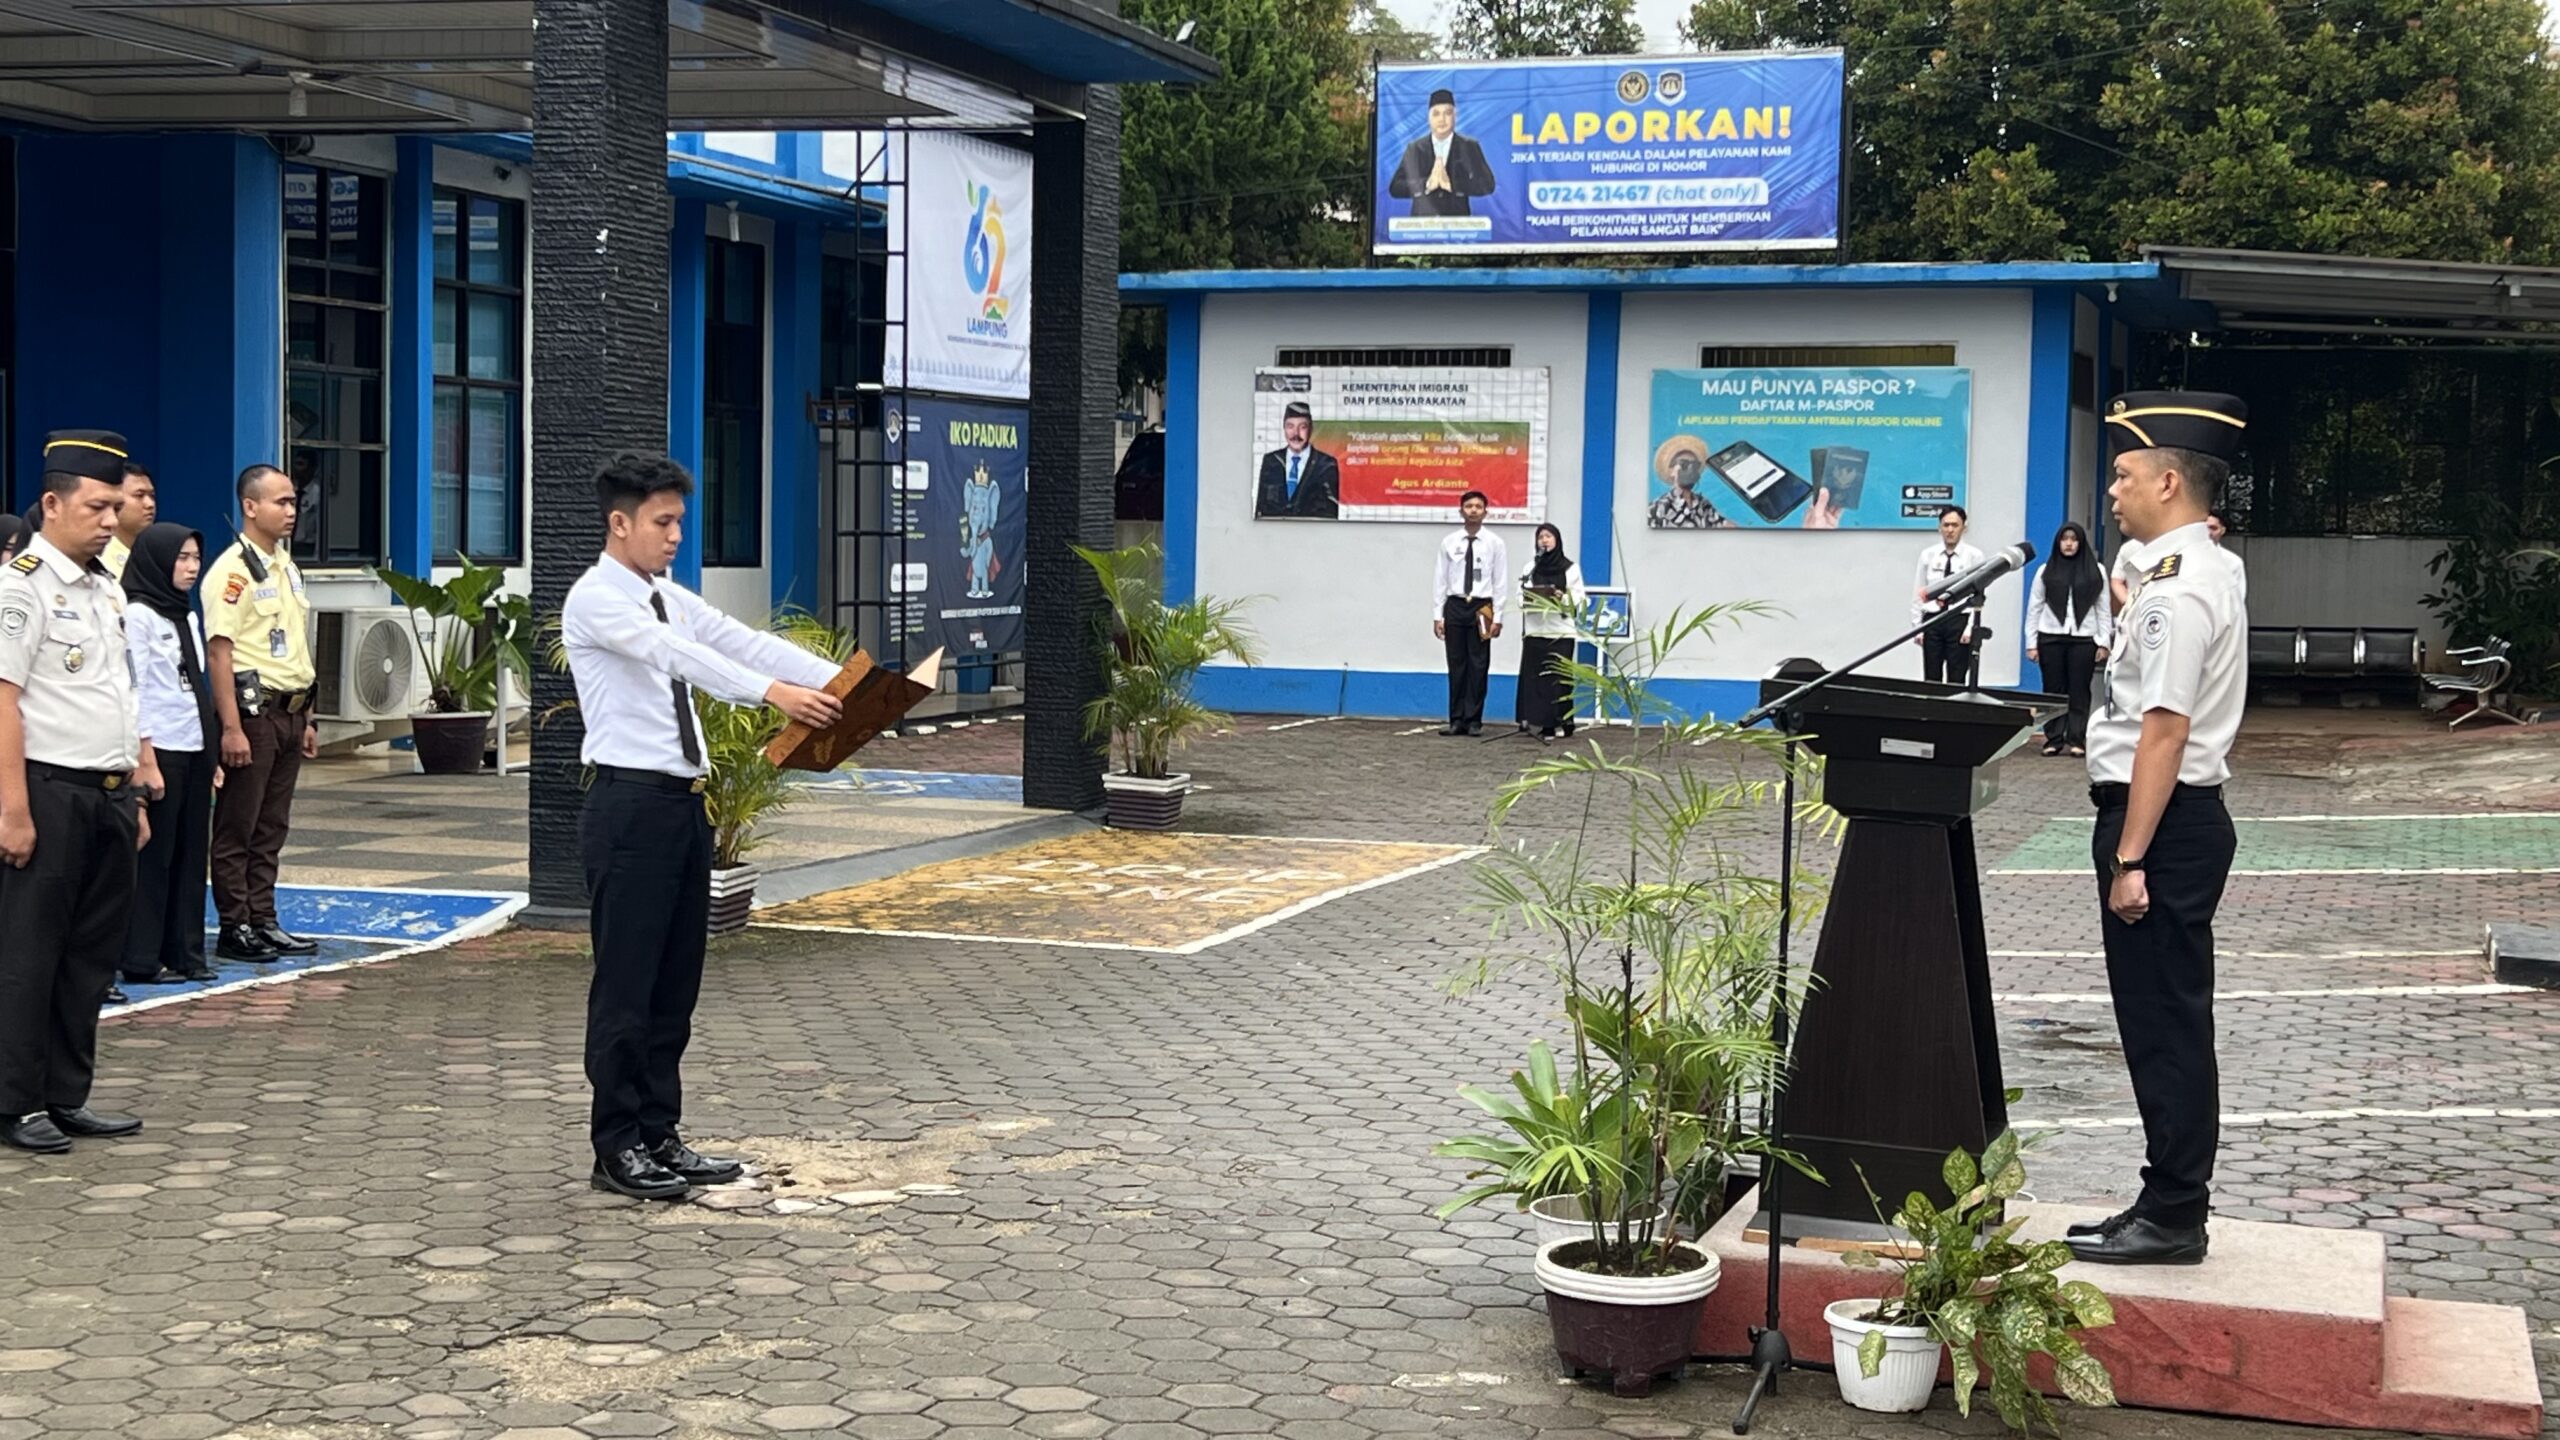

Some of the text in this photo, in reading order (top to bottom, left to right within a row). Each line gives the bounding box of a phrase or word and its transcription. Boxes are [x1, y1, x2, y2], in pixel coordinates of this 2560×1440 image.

[1511, 105, 1792, 145] LAPORKAN!
[1511, 145, 1792, 163] JIKA TERJADI KENDALA DALAM PELAYANAN KAMI
[1591, 160, 1707, 174] HUBUNGI DI NOMOR
[1537, 183, 1760, 203] 0724 21467 (chat only)
[1562, 213, 1646, 226] BERKOMITMEN
[1649, 213, 1689, 225] UNTUK
[1691, 211, 1771, 224] MEMBERIKAN
[1570, 225, 1640, 237] PELAYANAN
[1641, 224, 1688, 236] SANGAT
[967, 317, 1008, 339] LAMPUNG
[1342, 383, 1469, 393] KEMENTERIAN IMIGRASI
[1702, 378, 1916, 396] MAU PUNYA PASPOR ?
[1343, 396, 1466, 407] DAN PEMASYARAKATAN
[1740, 399, 1875, 412] DAFTAR M-PASPOR
[1731, 415, 1806, 426] PENDAFTARAN
[1857, 416, 1900, 426] PASPOR
[1902, 417, 1943, 427] ONLINE
[950, 420, 971, 447] IKO
[972, 422, 1018, 449] PADUKA
[1392, 478, 1469, 489] Agus Ardianto
[1013, 859, 1347, 883] DROP
[932, 874, 1287, 904] ZONE
